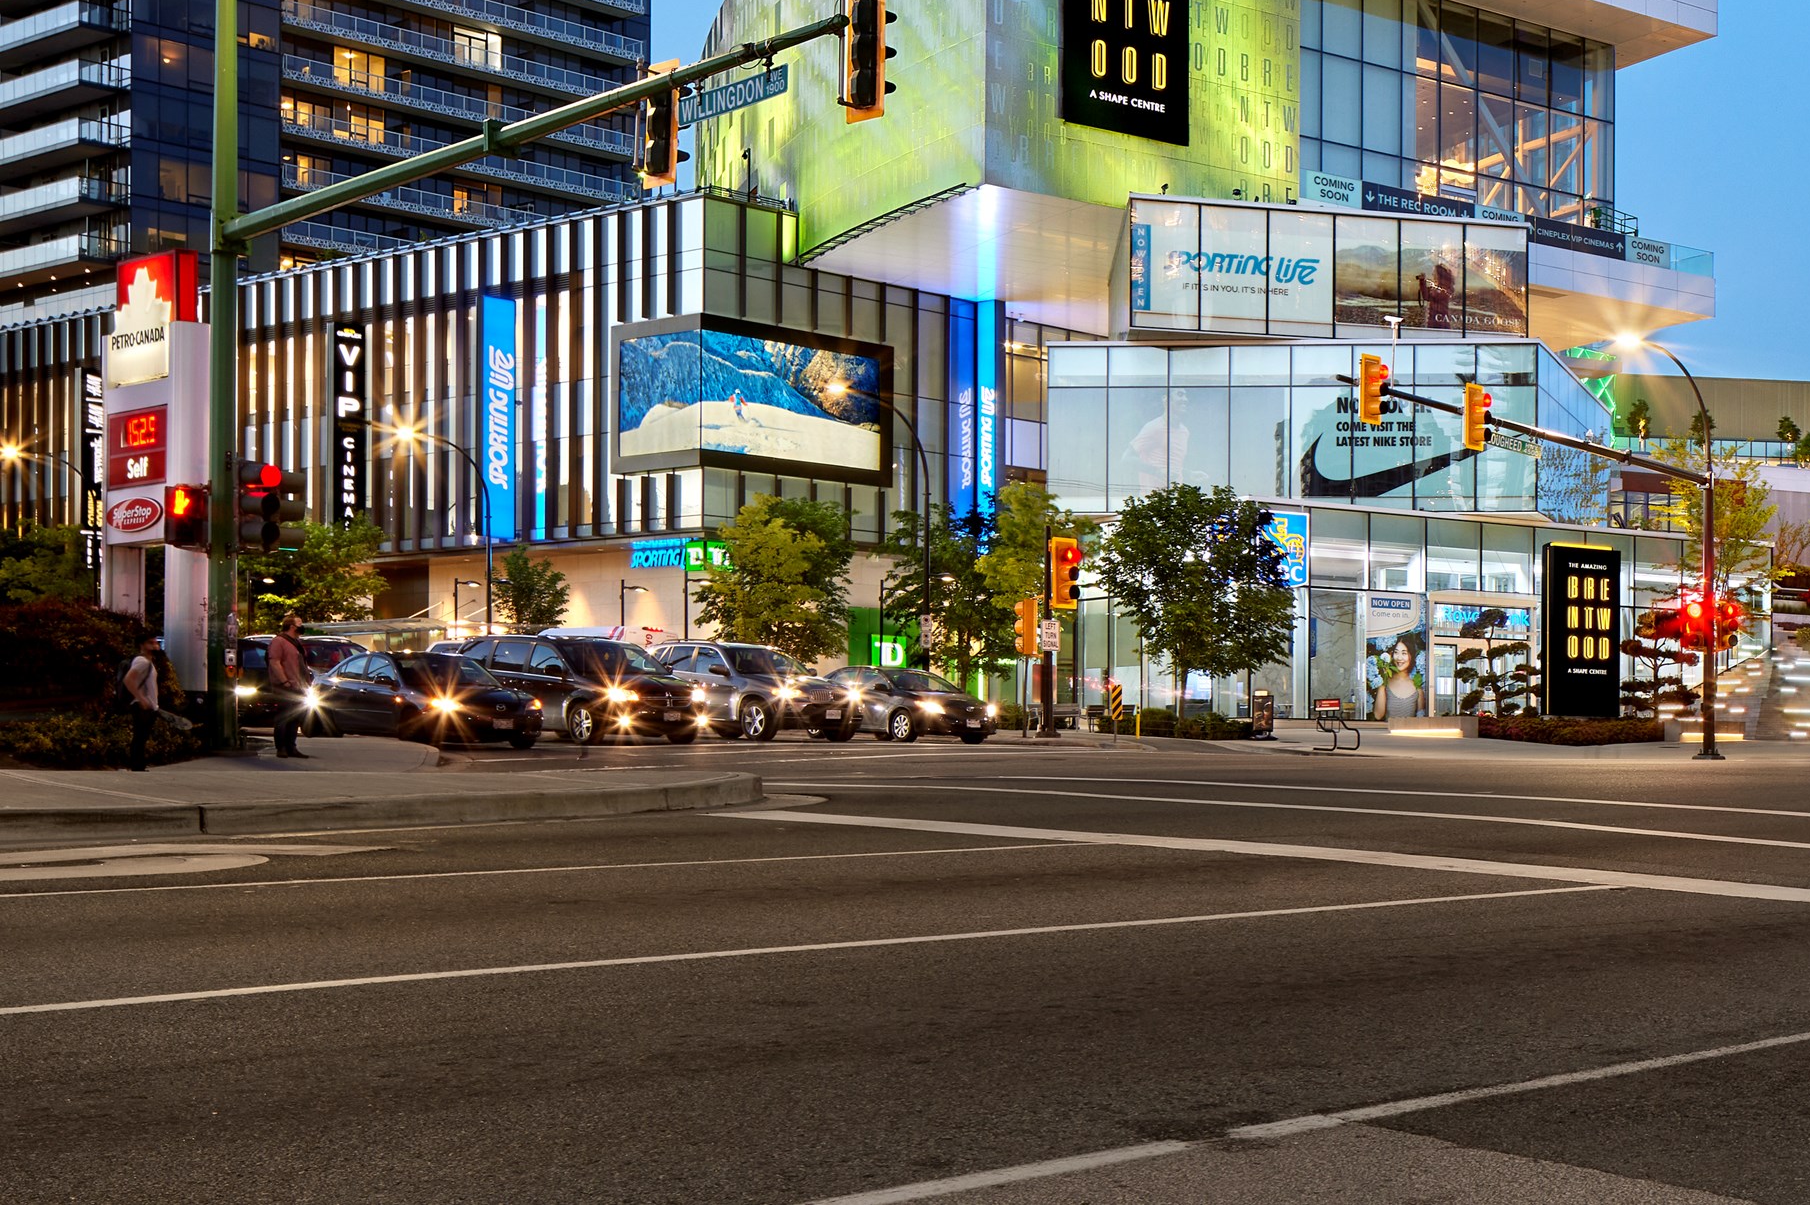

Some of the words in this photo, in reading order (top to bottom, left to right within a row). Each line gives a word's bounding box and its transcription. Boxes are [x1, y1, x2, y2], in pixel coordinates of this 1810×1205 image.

[769, 69, 784, 82] AVE
[766, 81, 785, 95] 1900
[681, 77, 764, 123] WILLINGDON
[1089, 89, 1098, 99] A
[1098, 91, 1129, 106] SHAPE
[1130, 98, 1166, 114] CENTRE
[1314, 176, 1355, 192] COMING
[1320, 188, 1349, 202] SOON
[1378, 193, 1398, 208] THE
[1401, 198, 1422, 212] REC
[1424, 203, 1456, 217] ROOM
[1481, 209, 1519, 222] COMING
[1536, 228, 1571, 241] CINEPLEX
[1570, 234, 1583, 243] VIP
[1583, 237, 1615, 250] CINEMAS
[1631, 240, 1665, 254] COMING
[1636, 252, 1661, 264] SOON
[1182, 282, 1190, 290] IF
[1210, 284, 1219, 292] IN
[1241, 286, 1257, 294] IT'S
[1257, 287, 1267, 295] IN
[1268, 288, 1289, 296] HERE
[1435, 314, 1480, 325] CANDA
[1483, 316, 1521, 327] GOOSE
[338, 344, 361, 418] VIP
[1336, 421, 1367, 432] COME
[1370, 421, 1400, 432] VISIT
[1401, 421, 1415, 432] THE
[1336, 436, 1371, 447] LATEST
[1373, 436, 1397, 447] NIKE
[1404, 436, 1432, 447] STORE
[127, 457, 149, 480] Self
[112, 504, 152, 522] SuperStop
[123, 517, 145, 525] EXPRESS
[1581, 563, 1608, 571] AMAZING
[1372, 599, 1390, 607] NOW
[1391, 600, 1410, 608] OPEN
[1372, 610, 1392, 618] Come
[1043, 639, 1059, 648] SIGNAL
[874, 641, 903, 666] TD
